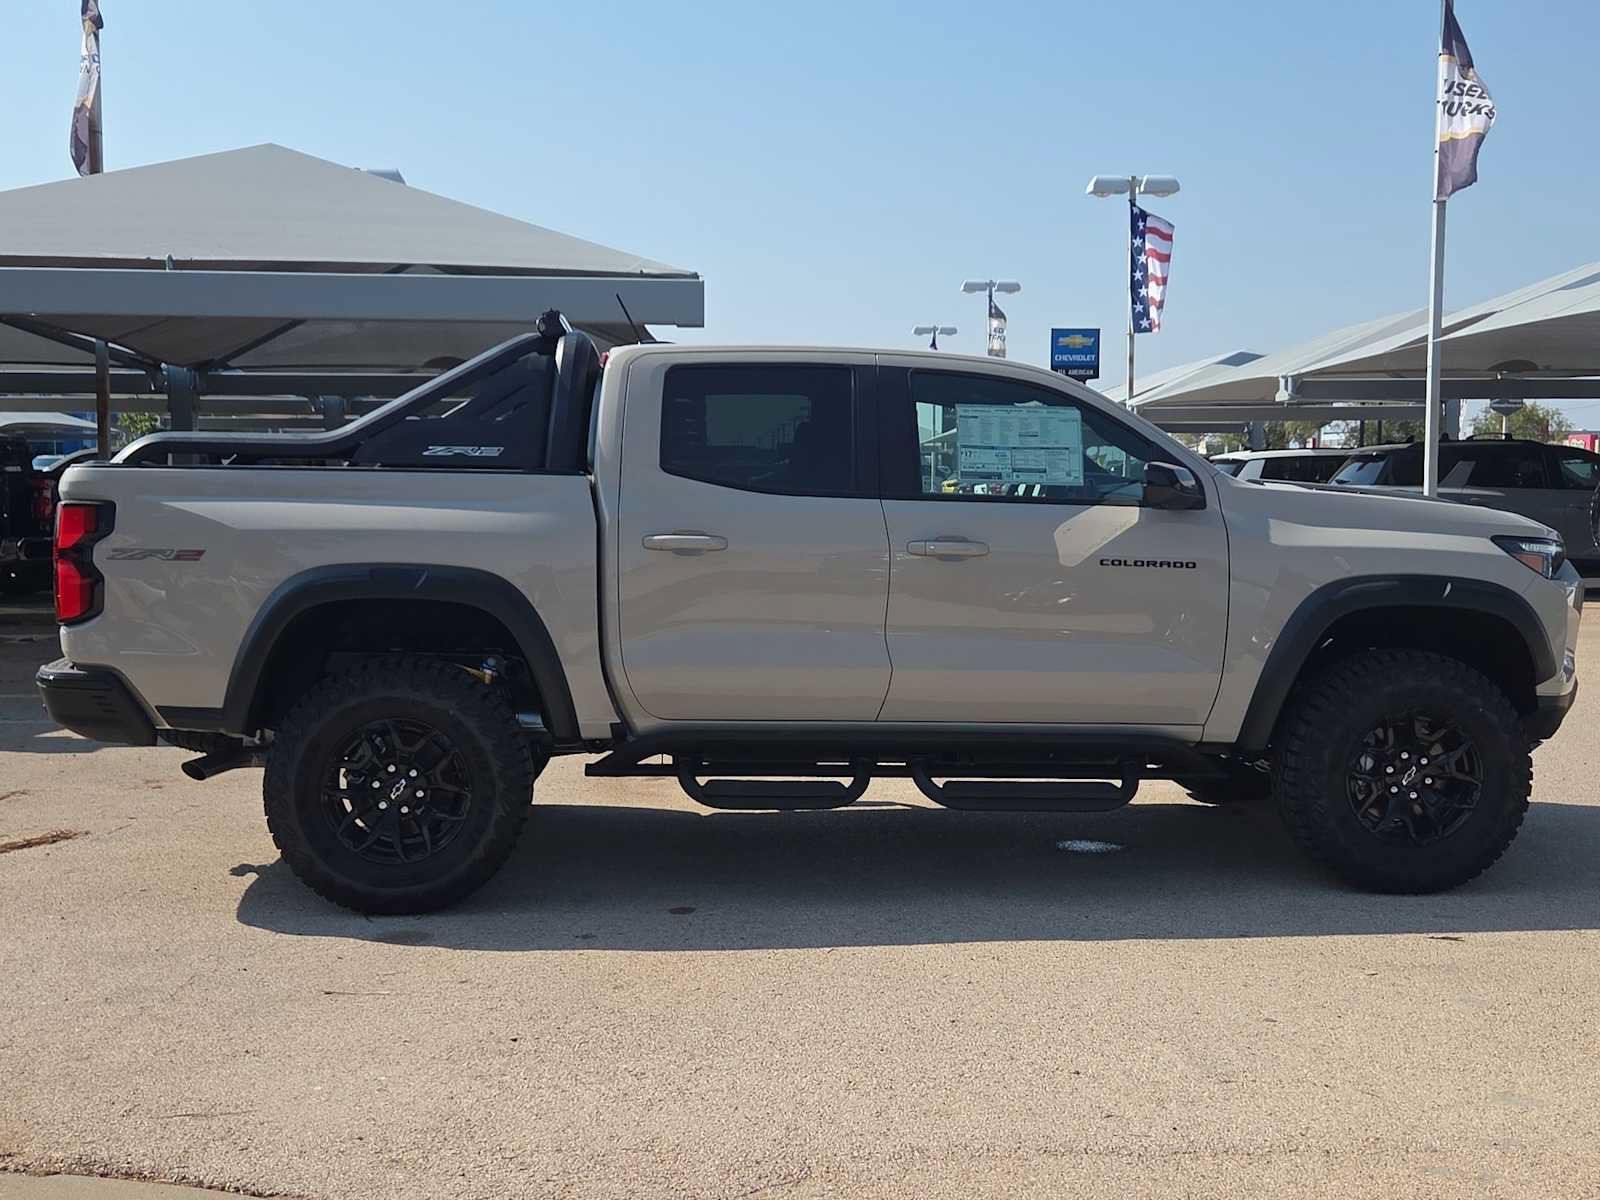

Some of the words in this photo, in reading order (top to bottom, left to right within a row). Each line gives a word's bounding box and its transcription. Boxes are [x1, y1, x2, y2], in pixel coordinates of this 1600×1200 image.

[422, 446, 504, 456] ZR2
[105, 548, 206, 561] ZR2
[1099, 559, 1197, 569] COLORADO
